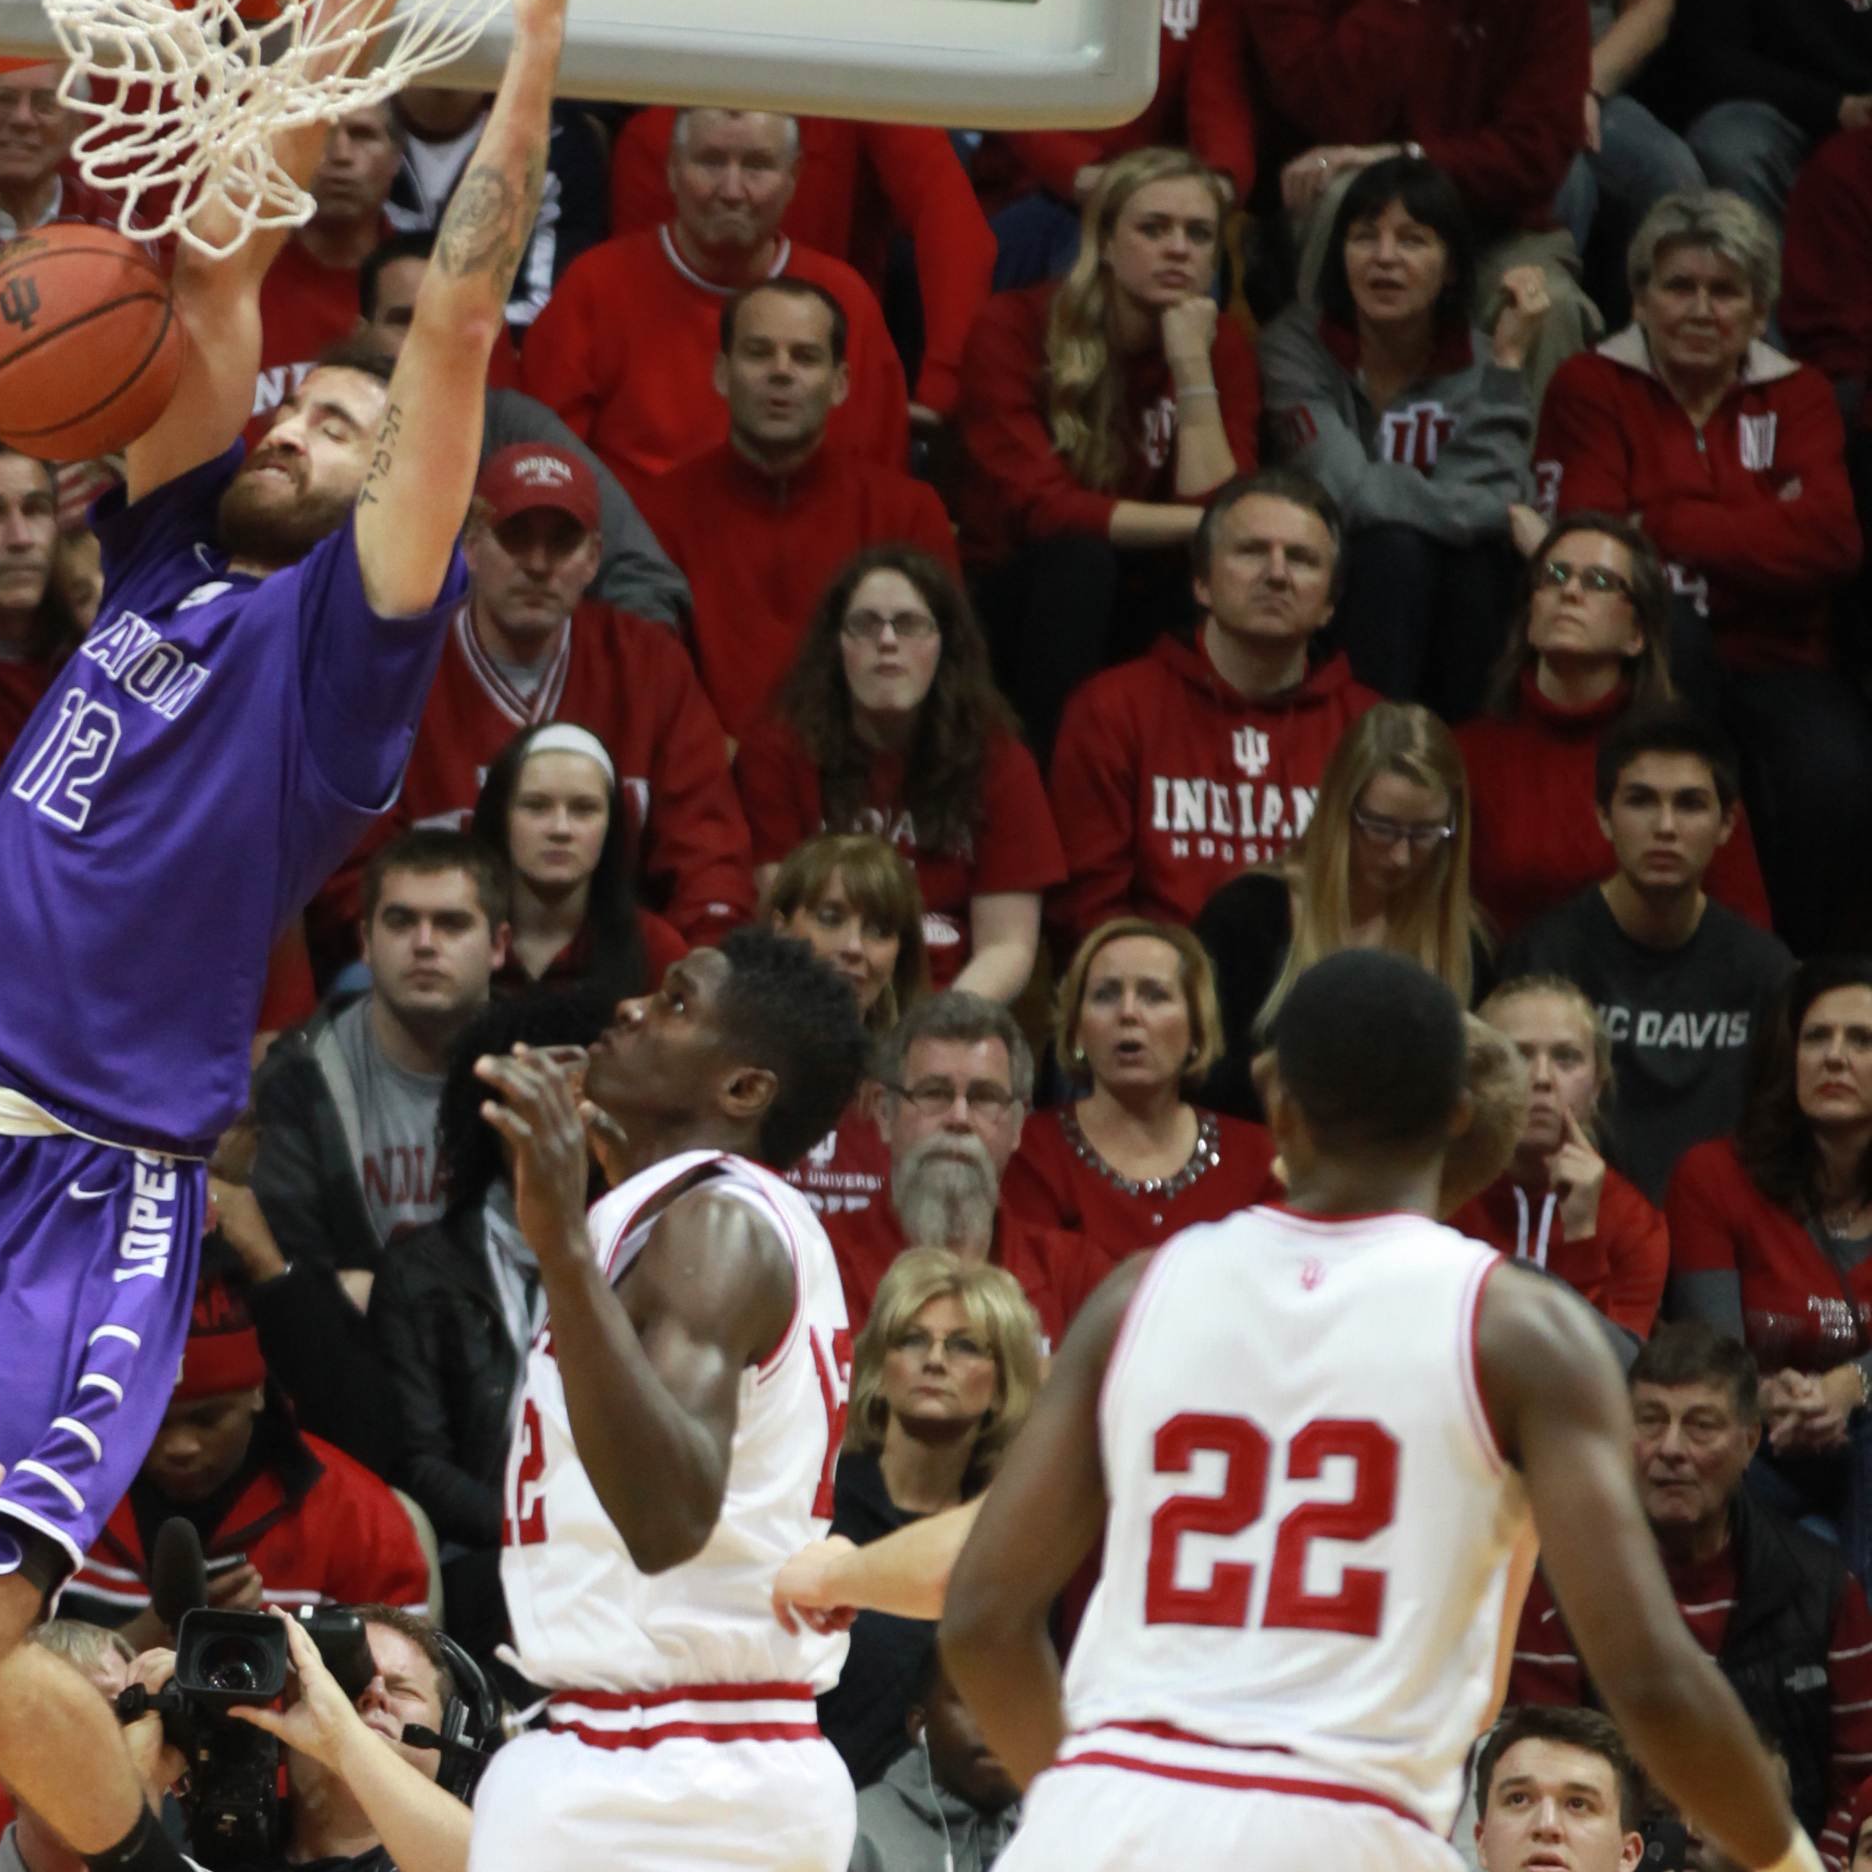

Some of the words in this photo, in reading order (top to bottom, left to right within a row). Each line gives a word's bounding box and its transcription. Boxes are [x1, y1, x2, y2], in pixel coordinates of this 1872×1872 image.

[11, 686, 122, 833] 12
[1151, 773, 1320, 840] INDIAN
[1634, 1009, 1749, 1049] DAVIS
[1145, 1413, 1399, 1637] 22
